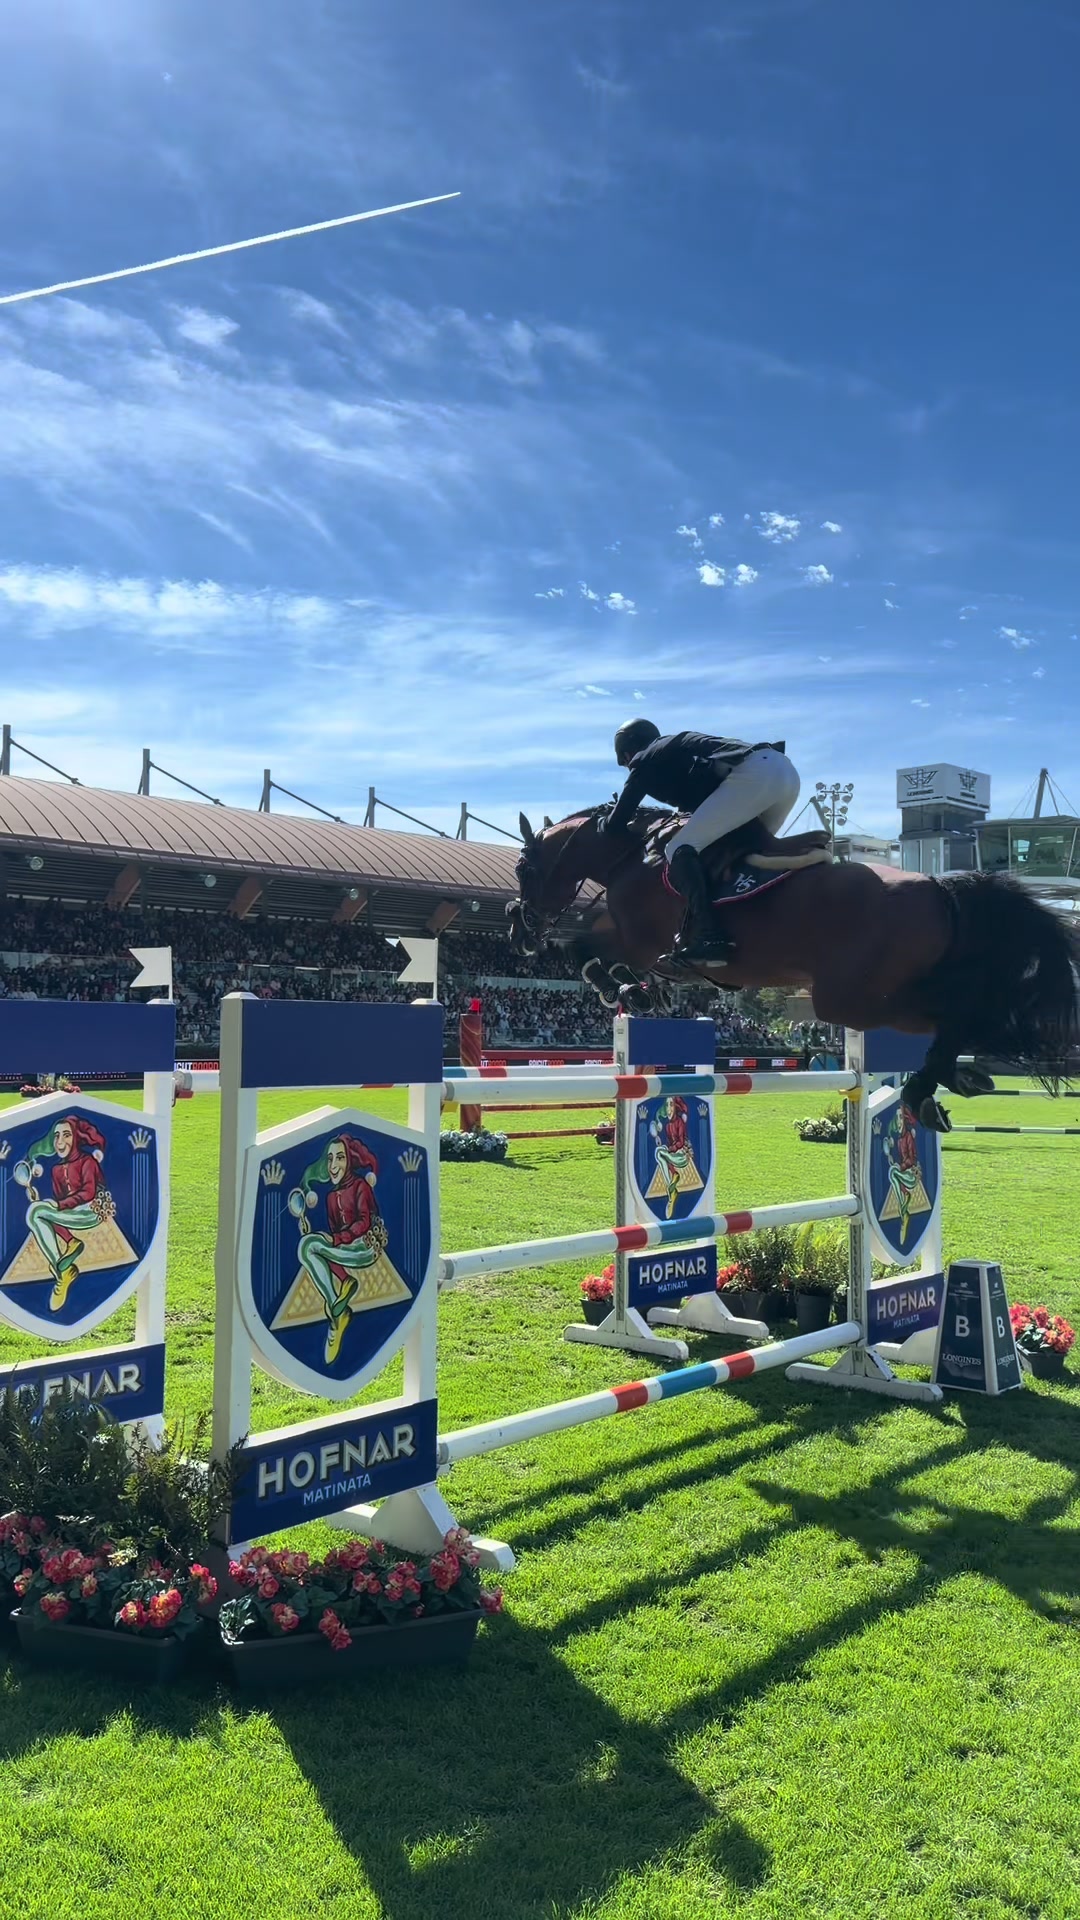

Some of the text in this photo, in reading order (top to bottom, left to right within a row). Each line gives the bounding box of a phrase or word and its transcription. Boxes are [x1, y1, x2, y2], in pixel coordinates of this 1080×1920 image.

[639, 1256, 707, 1286] HOFNAR
[657, 1280, 688, 1293] MATINATA
[876, 1286, 936, 1321] HOFNAR
[893, 1313, 920, 1329] MATINATA
[955, 1314, 970, 1338] B
[996, 1315, 1005, 1338] B
[942, 1353, 982, 1366] LONGINES
[257, 1423, 416, 1498] HOFNAR
[303, 1473, 371, 1505] MATINATA
